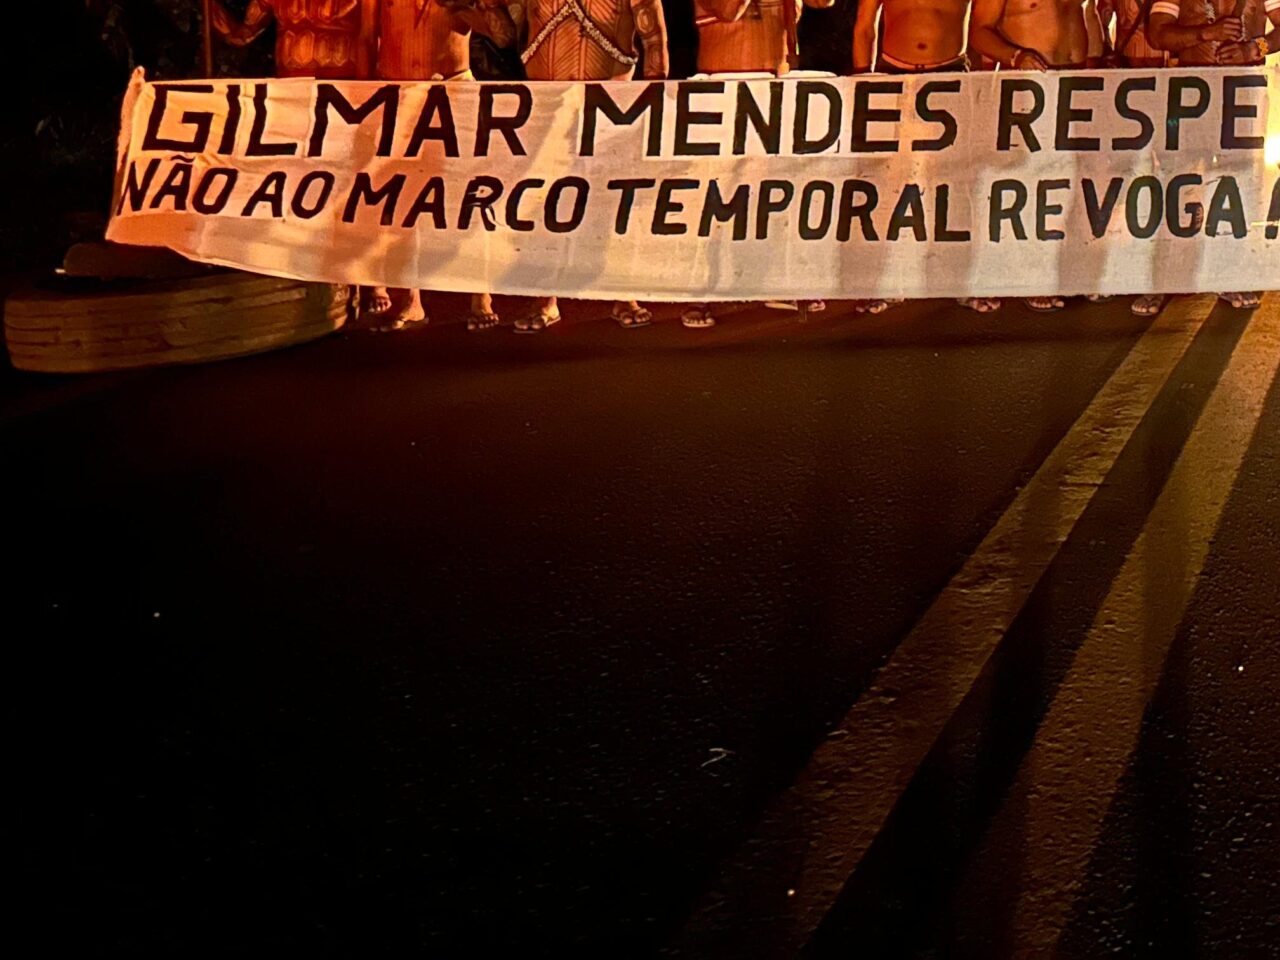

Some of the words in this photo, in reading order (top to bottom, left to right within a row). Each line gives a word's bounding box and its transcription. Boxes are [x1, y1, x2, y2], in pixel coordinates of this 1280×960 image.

[142, 83, 533, 157] GILMAR
[580, 80, 961, 157] MENDES
[117, 155, 239, 216] NÃO
[240, 170, 336, 219] AO
[342, 172, 590, 232] MARCO
[606, 177, 971, 242] TEMPORAL
[988, 174, 1247, 242] REVOGA
